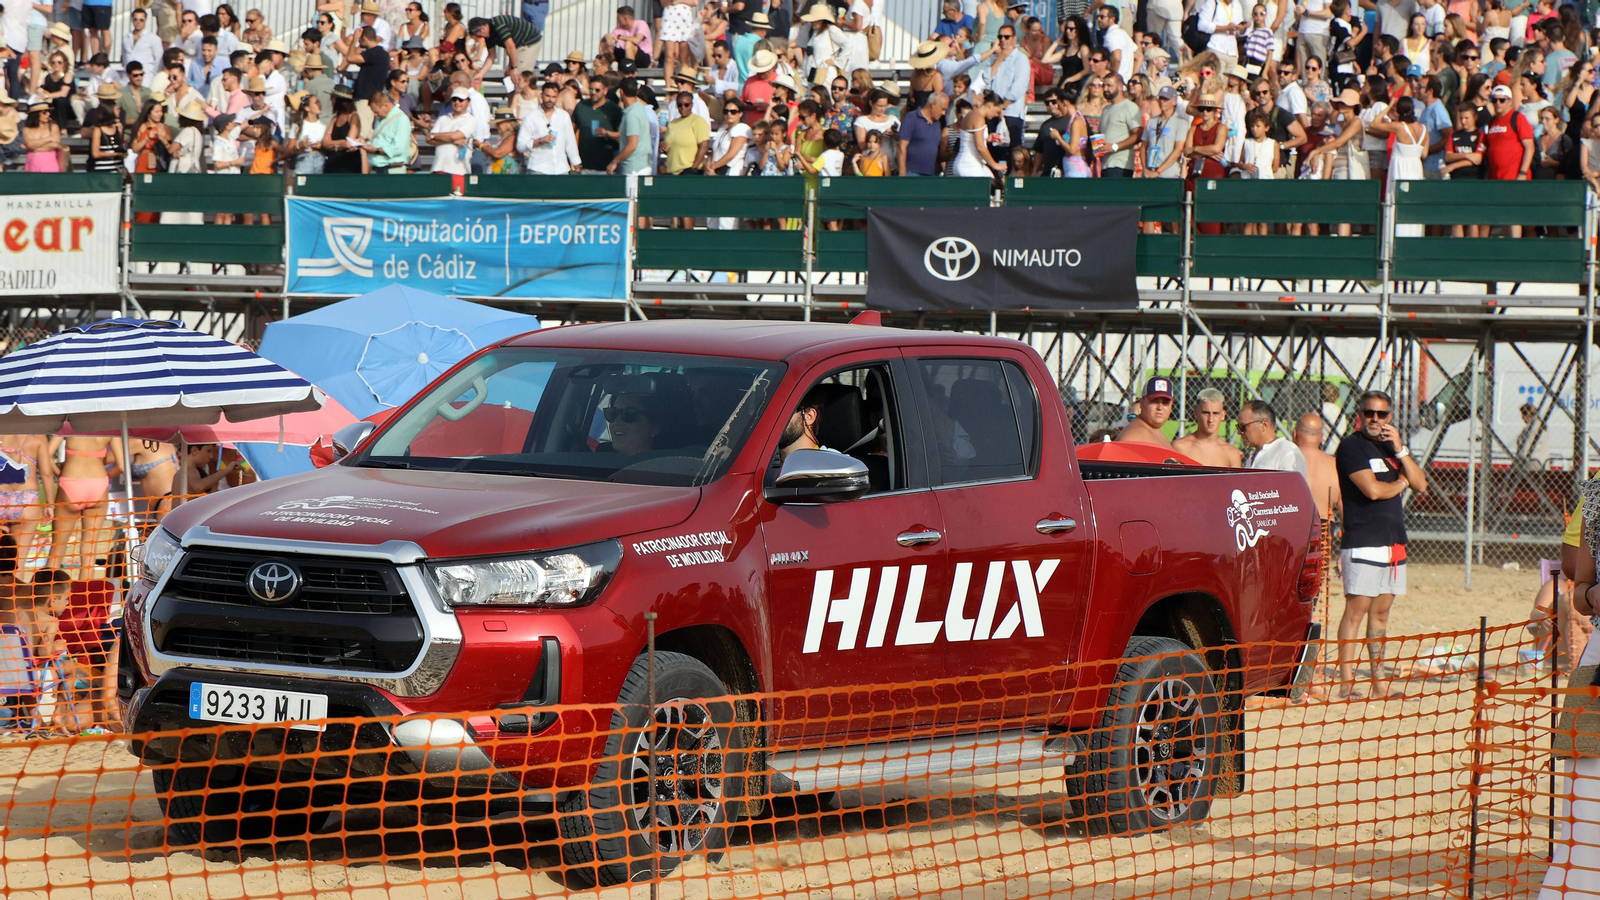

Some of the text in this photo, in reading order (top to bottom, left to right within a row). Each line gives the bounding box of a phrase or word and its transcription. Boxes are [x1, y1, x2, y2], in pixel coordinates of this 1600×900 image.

[7, 199, 93, 209] MANZANILLA
[383, 217, 498, 247] Diputación
[520, 223, 621, 245] DEPORTES
[383, 253, 477, 280] de Cádiz
[992, 248, 1082, 267] NIMAUTO
[1248, 489, 1280, 500] Real Sociedad
[1253, 504, 1299, 516] Carreras de Caballos
[348, 515, 393, 526] OFICIAL
[1256, 518, 1277, 527] SANLÚCAR
[632, 530, 732, 556] PATROCINADOR OFICIAL
[665, 549, 725, 568] DE MOVILIDAD
[802, 558, 1061, 654] HILUX
[192, 689, 318, 727] E 9233 MJL
